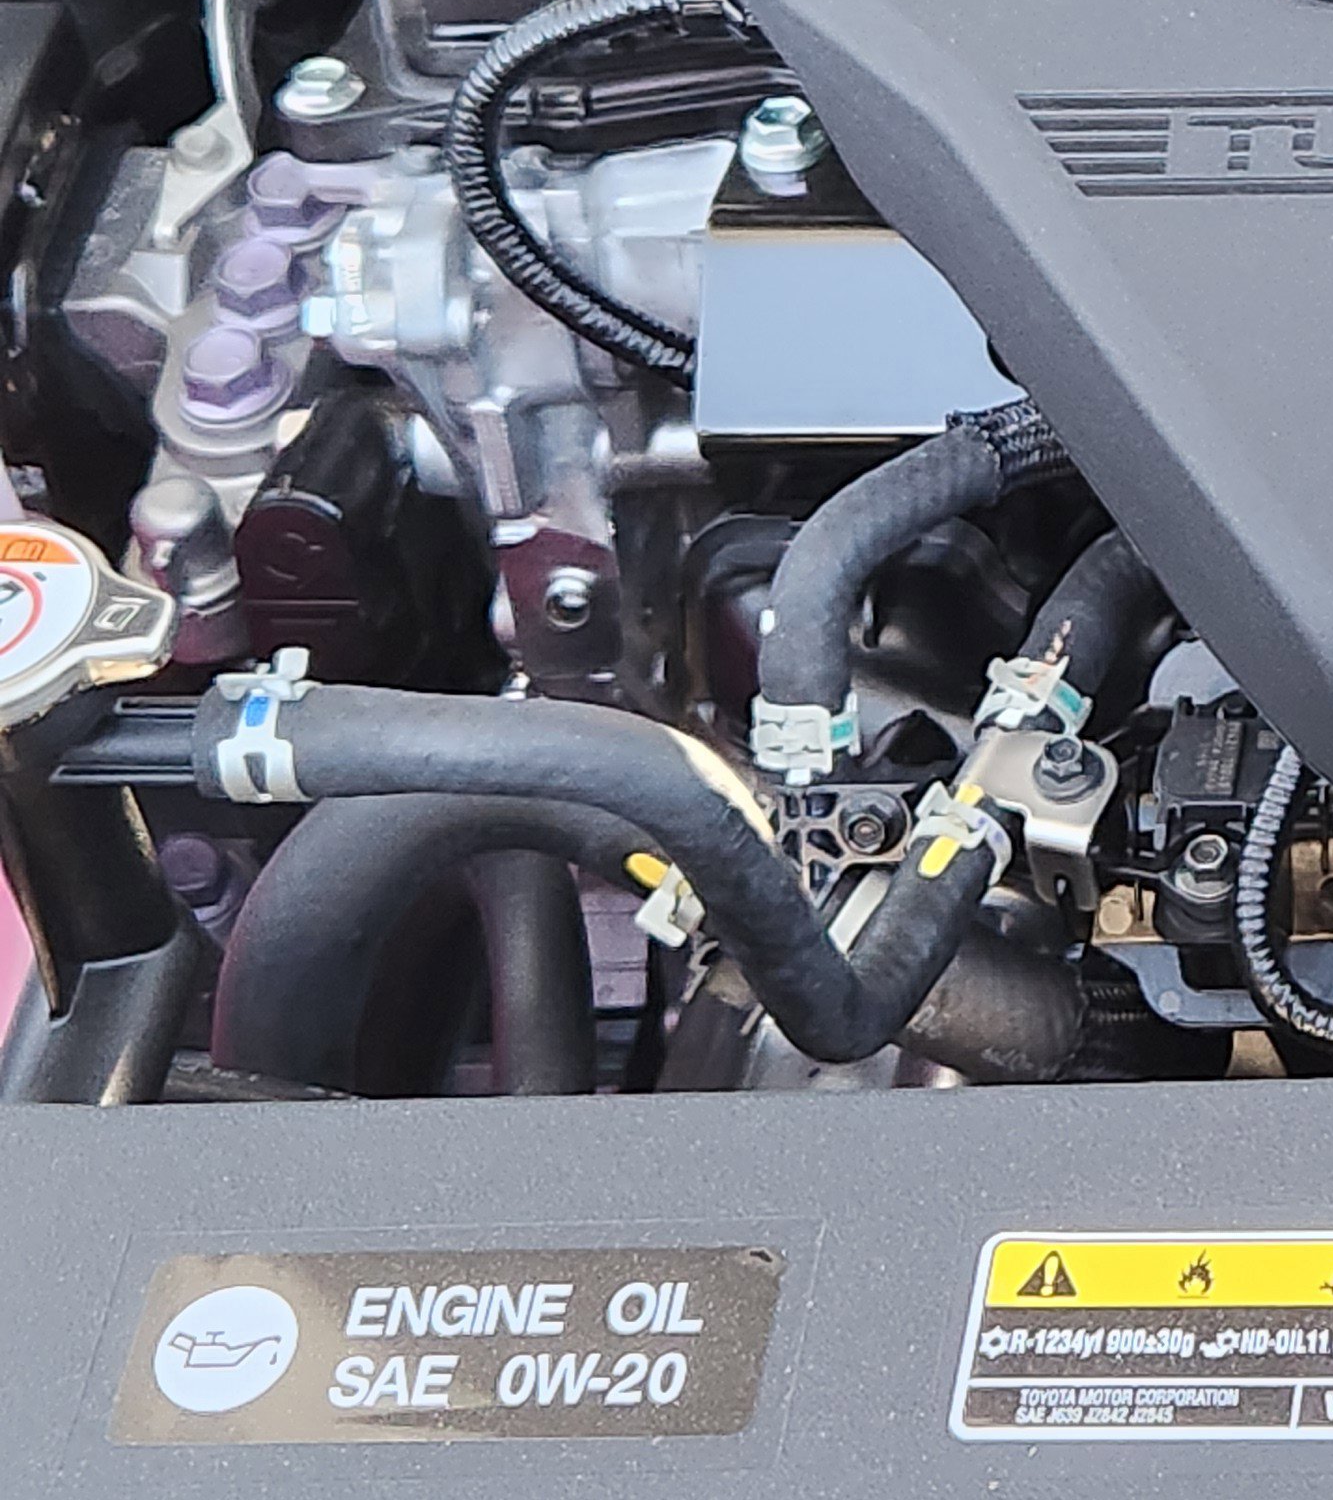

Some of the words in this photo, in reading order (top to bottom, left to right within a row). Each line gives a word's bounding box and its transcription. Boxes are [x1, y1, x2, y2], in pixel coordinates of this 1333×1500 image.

[344, 1282, 573, 1338] ENGINE
[607, 1282, 703, 1336] OIL
[328, 1354, 459, 1409] SAE
[499, 1352, 687, 1408] 0W-20
[1019, 1389, 1076, 1406] TOYOTA
[1078, 1389, 1133, 1406] MOTOR
[1135, 1388, 1239, 1407] CORPORATION
[1015, 1406, 1046, 1424] SAE
